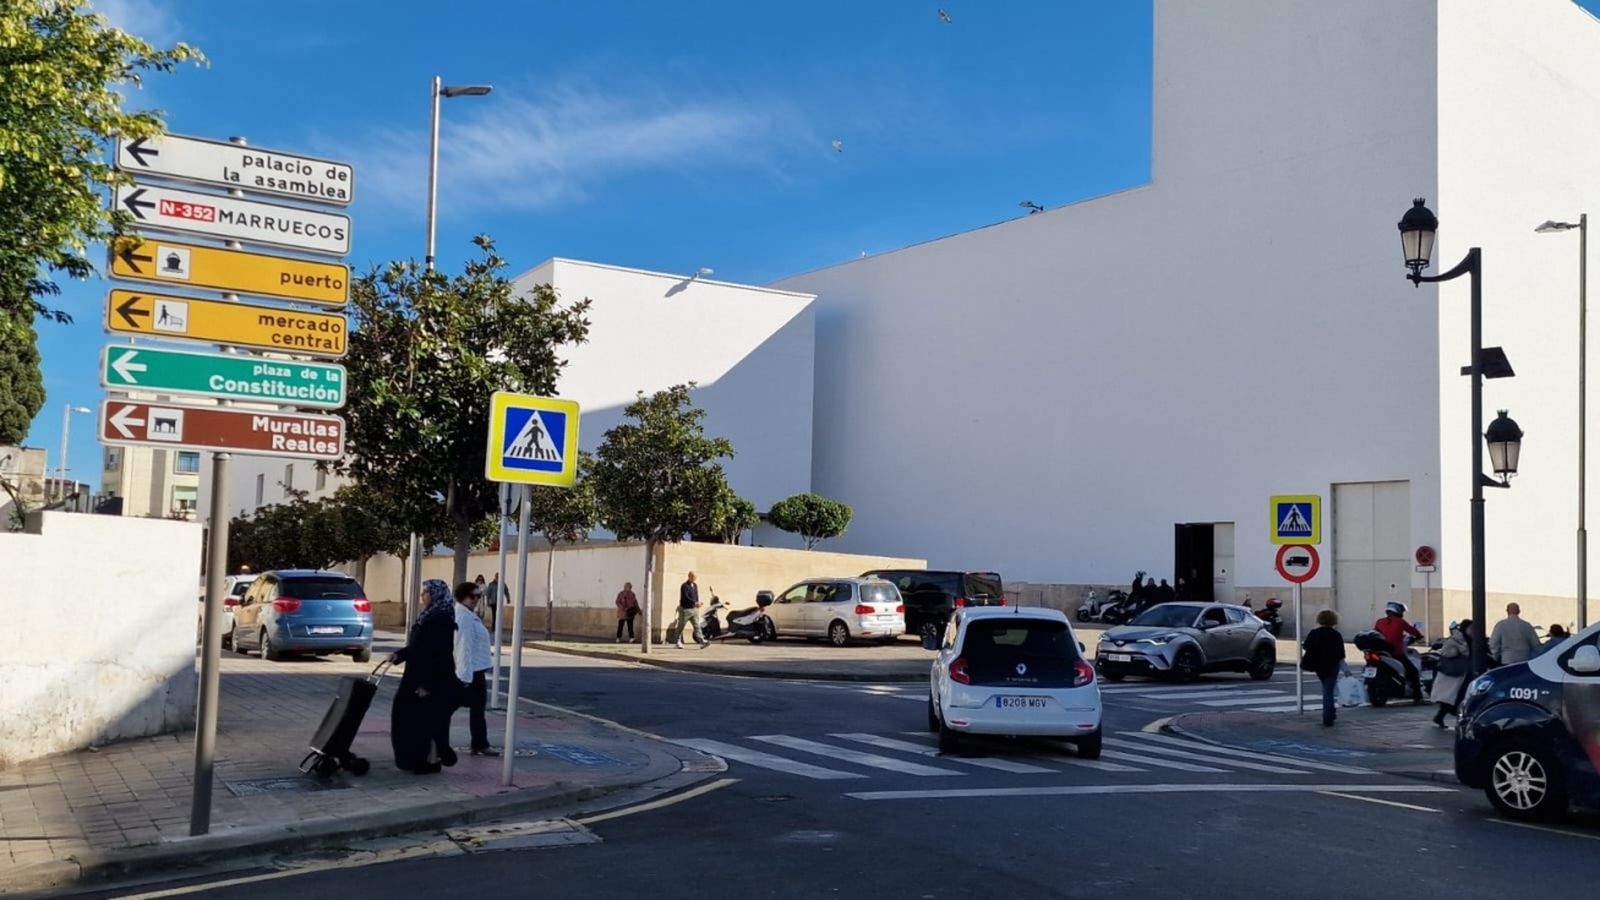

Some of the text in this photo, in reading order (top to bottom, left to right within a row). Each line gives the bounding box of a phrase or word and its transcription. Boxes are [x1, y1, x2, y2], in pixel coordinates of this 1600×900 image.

[242, 154, 348, 182] palacio de
[223, 166, 347, 200] la asamblea
[161, 200, 346, 241] N-352 MARRUECOS
[280, 271, 343, 290] puerto
[258, 314, 341, 334] mercado
[271, 332, 341, 350] central
[253, 364, 339, 382] plaza de la
[209, 374, 339, 401] Constitución
[252, 415, 339, 437] Murallas
[271, 435, 338, 454] Reales
[1003, 698, 1047, 709] 8208 MGV
